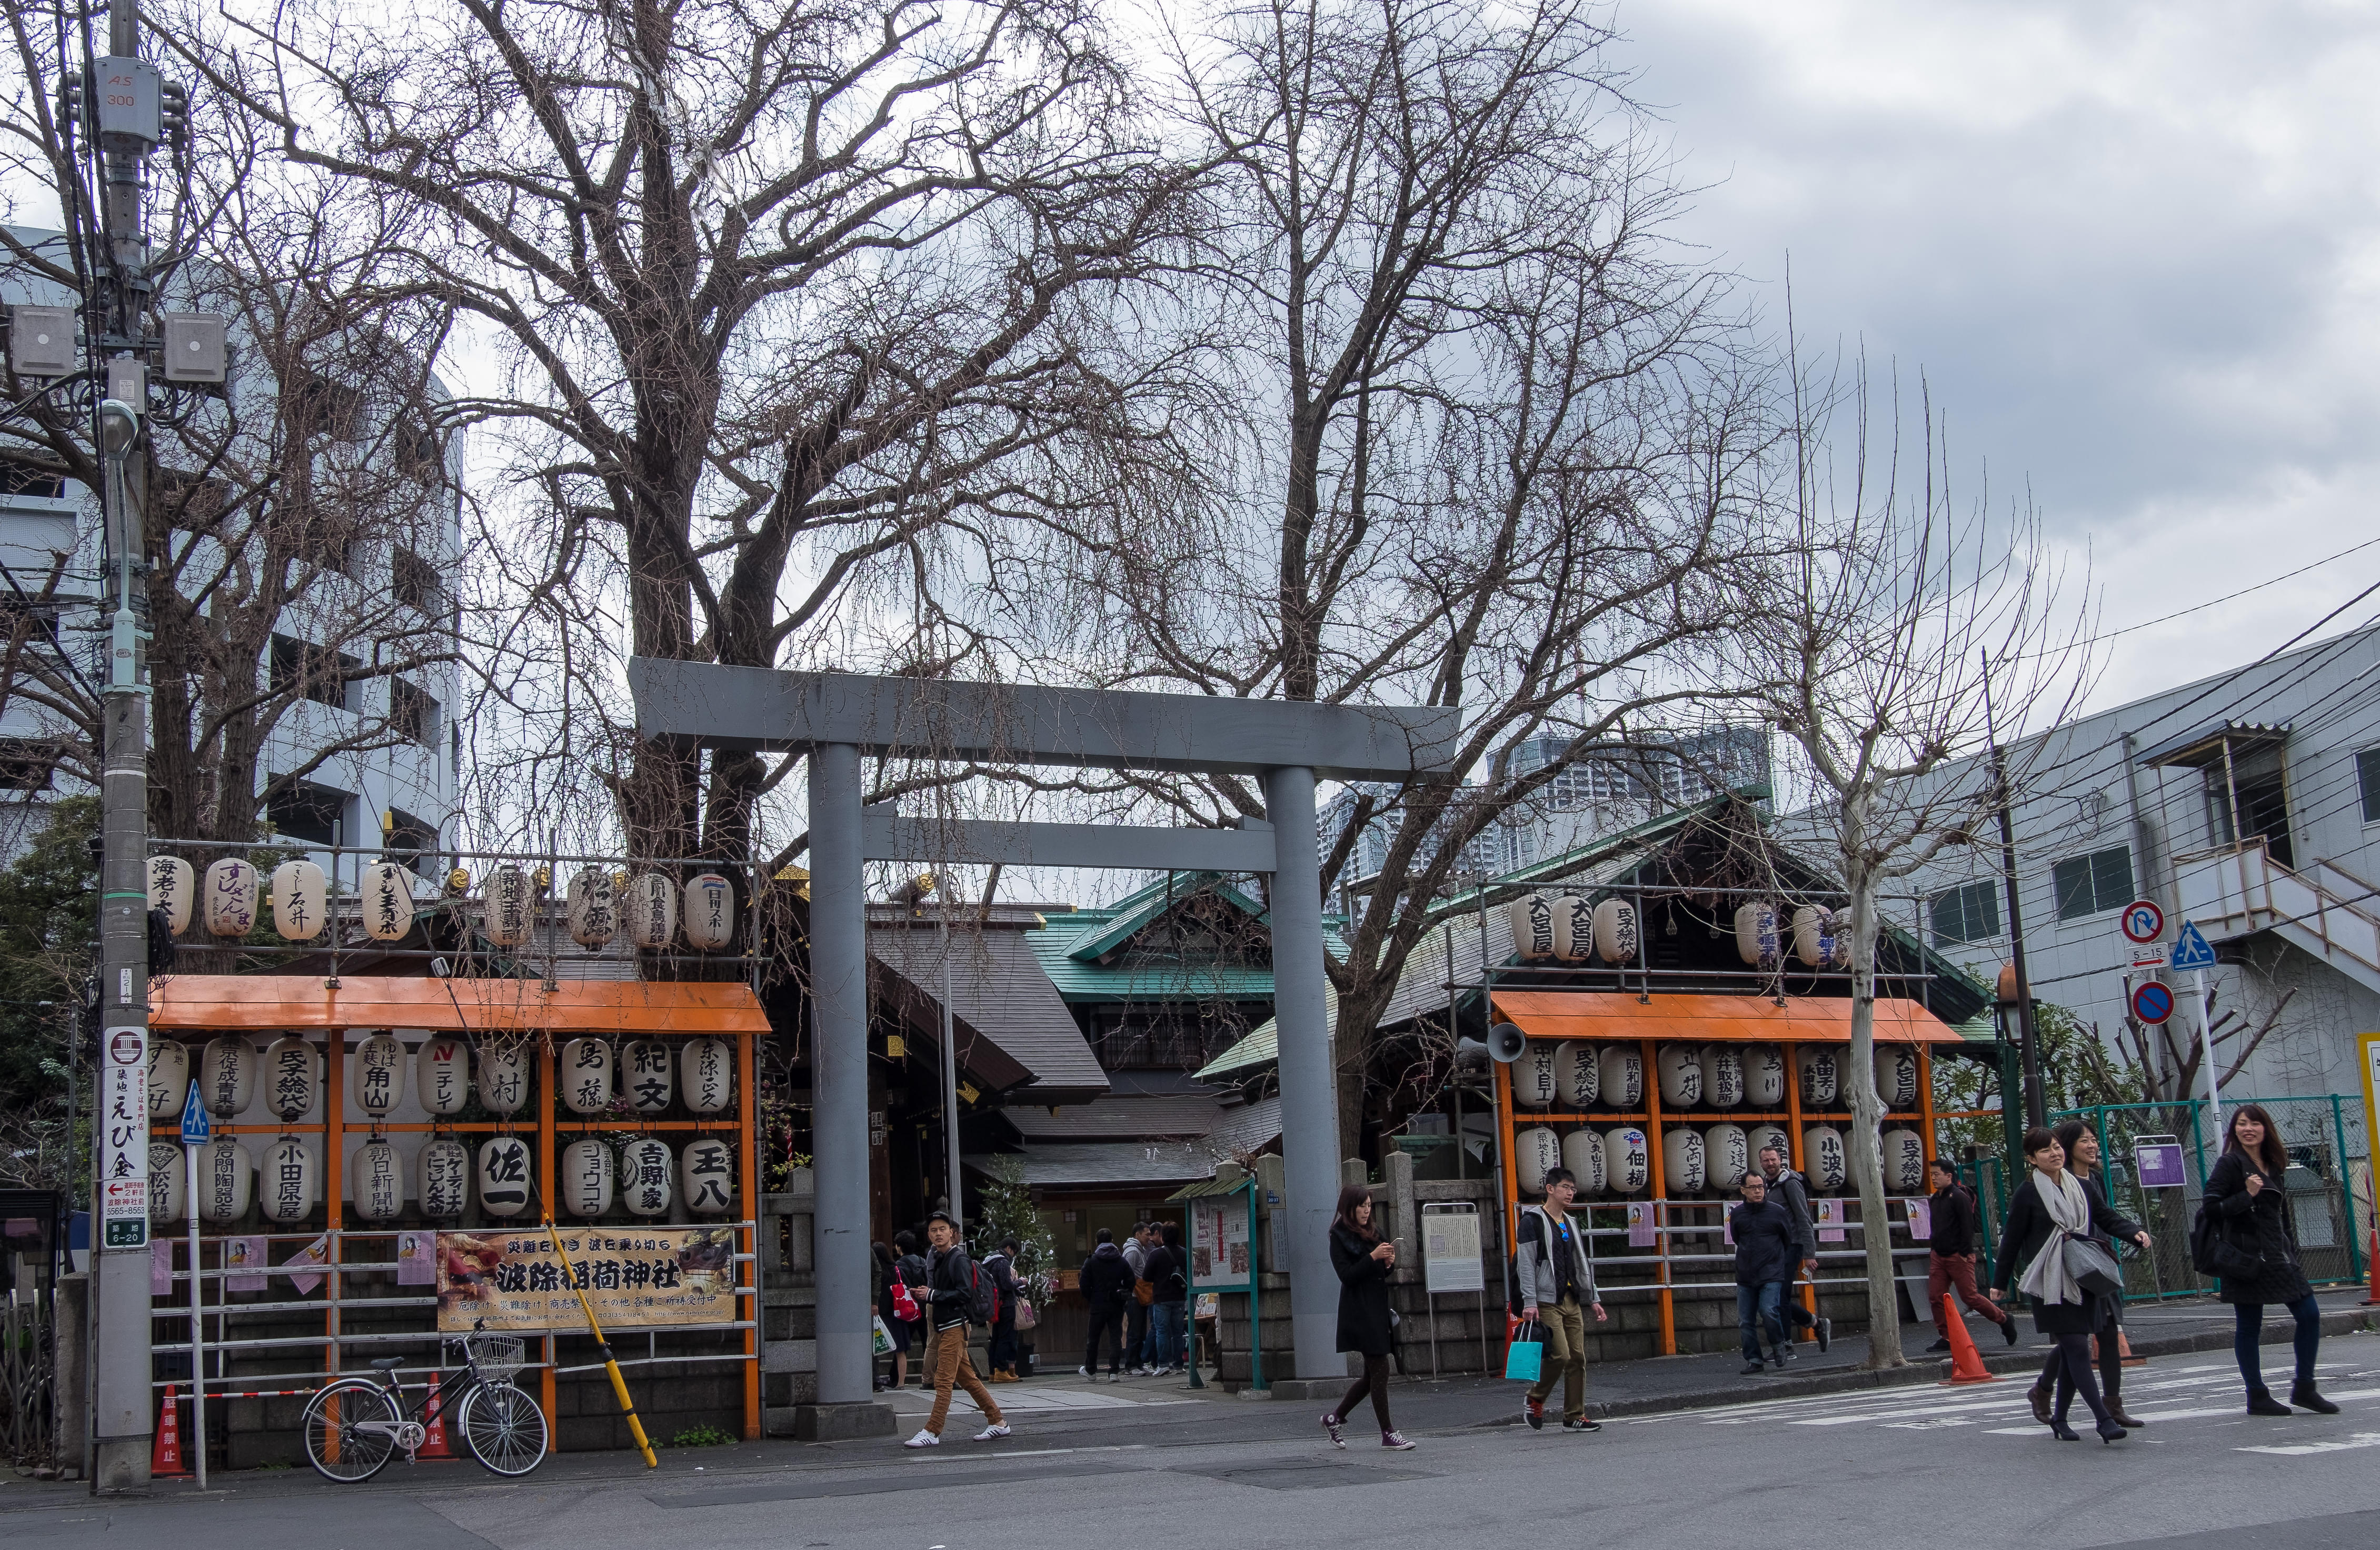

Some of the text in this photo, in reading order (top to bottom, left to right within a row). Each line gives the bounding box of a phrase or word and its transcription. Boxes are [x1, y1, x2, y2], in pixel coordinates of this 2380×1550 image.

[107, 95, 134, 106] 300
[152, 859, 177, 930] 海老の大
[218, 863, 251, 933] すしざんまい
[708, 889, 723, 945] 日刊スポーツ
[1528, 896, 1554, 954] 大宮屋
[1568, 899, 1592, 959] 大宮屋
[1615, 907, 1636, 961] 氏子総代会
[382, 1043, 397, 1067] ゆば
[633, 1043, 669, 1108] 紀文
[1574, 1049, 1597, 1104] 氏子総代会
[1895, 1052, 1915, 1104] 大宮屋
[275, 1049, 311, 1120] 氏子総代会
[364, 1066, 390, 1108] 角山
[435, 1063, 453, 1110] ニチレイ
[108, 1068, 136, 1179] 築地 えび金
[277, 1145, 306, 1219] 小田原屋
[369, 1147, 394, 1217] 朝日新聞社
[639, 1143, 664, 1209] 吉野家
[1821, 1137, 1843, 1188] 小波会
[107, 1206, 145, 1215] 5565-8553
[113, 1234, 138, 1242] 6-20
[587, 1237, 672, 1252] 波を乗り切る
[495, 1257, 681, 1294] 波除稲荷神社
